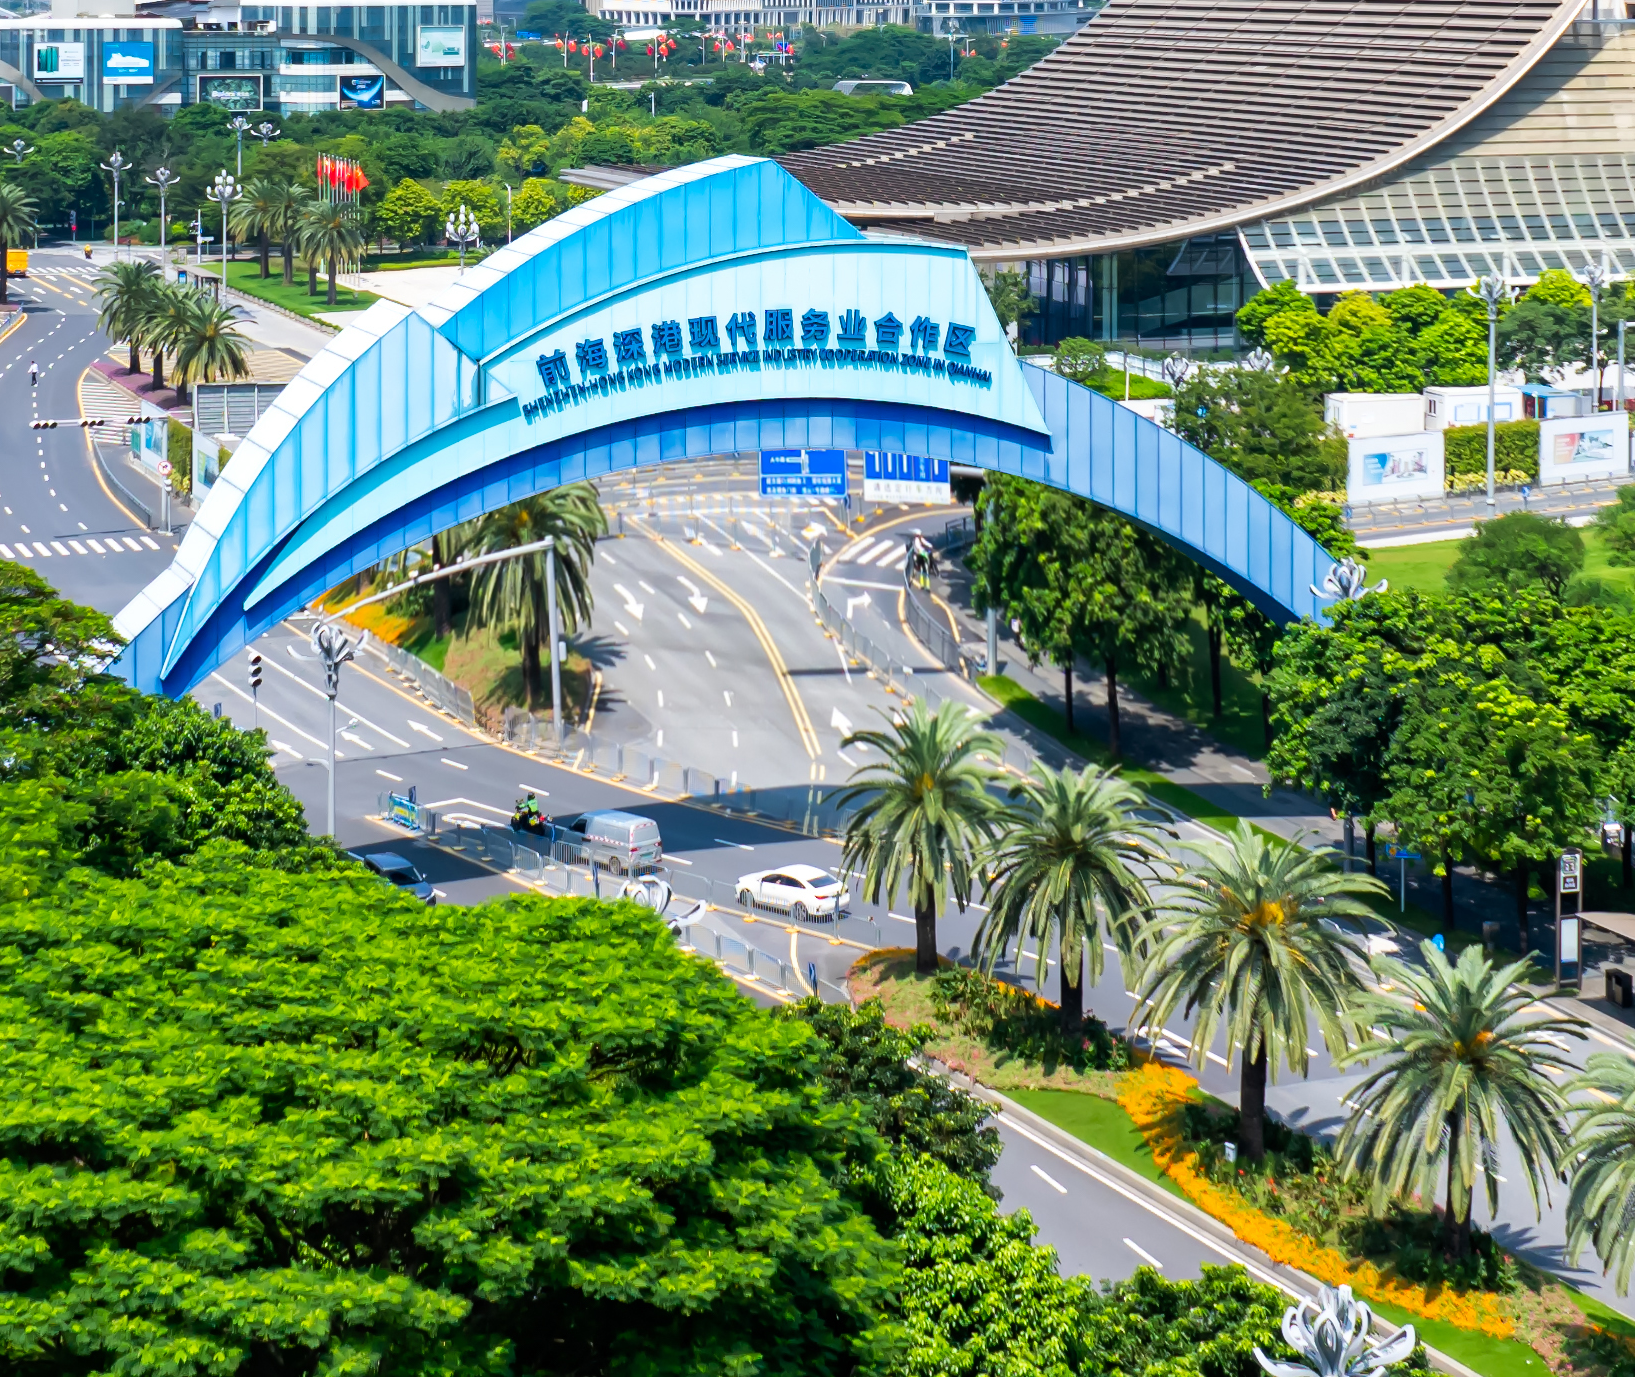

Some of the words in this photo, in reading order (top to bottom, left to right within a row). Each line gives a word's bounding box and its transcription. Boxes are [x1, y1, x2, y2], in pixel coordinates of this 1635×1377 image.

[535, 308, 976, 388] 前海深港现代服务业合作区
[627, 362, 662, 380] KONG
[663, 353, 715, 373] MODERN
[716, 350, 760, 366] SERVICE
[763, 348, 817, 363] INDUSTRY
[819, 348, 899, 364] COOPERATION
[900, 353, 933, 370] ZONE
[933, 357, 946, 371] IN
[947, 360, 993, 382] QIANHAI
